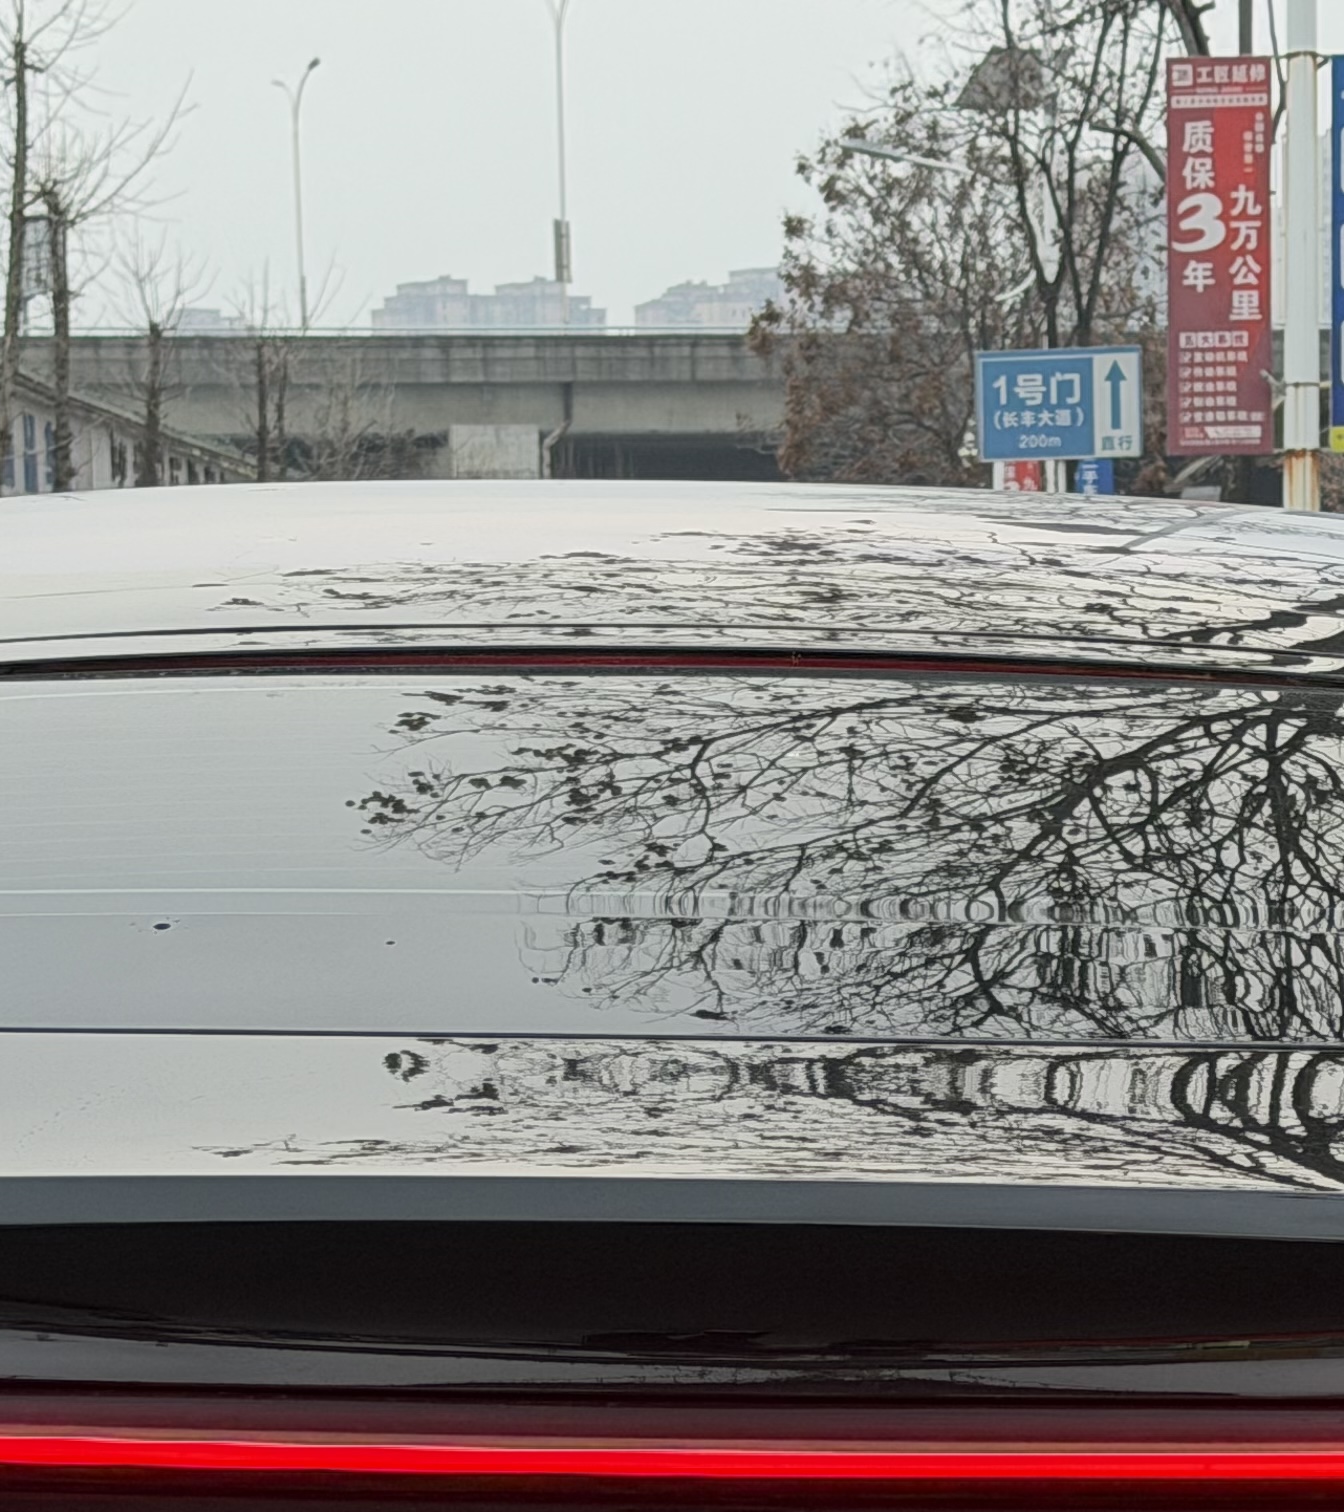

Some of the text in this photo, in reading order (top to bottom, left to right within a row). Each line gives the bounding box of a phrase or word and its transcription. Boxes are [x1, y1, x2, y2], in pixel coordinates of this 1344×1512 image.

[1229, 184, 1263, 322] 九万公里
[992, 371, 1081, 406] 1号门
[1019, 434, 1062, 449] 200m
